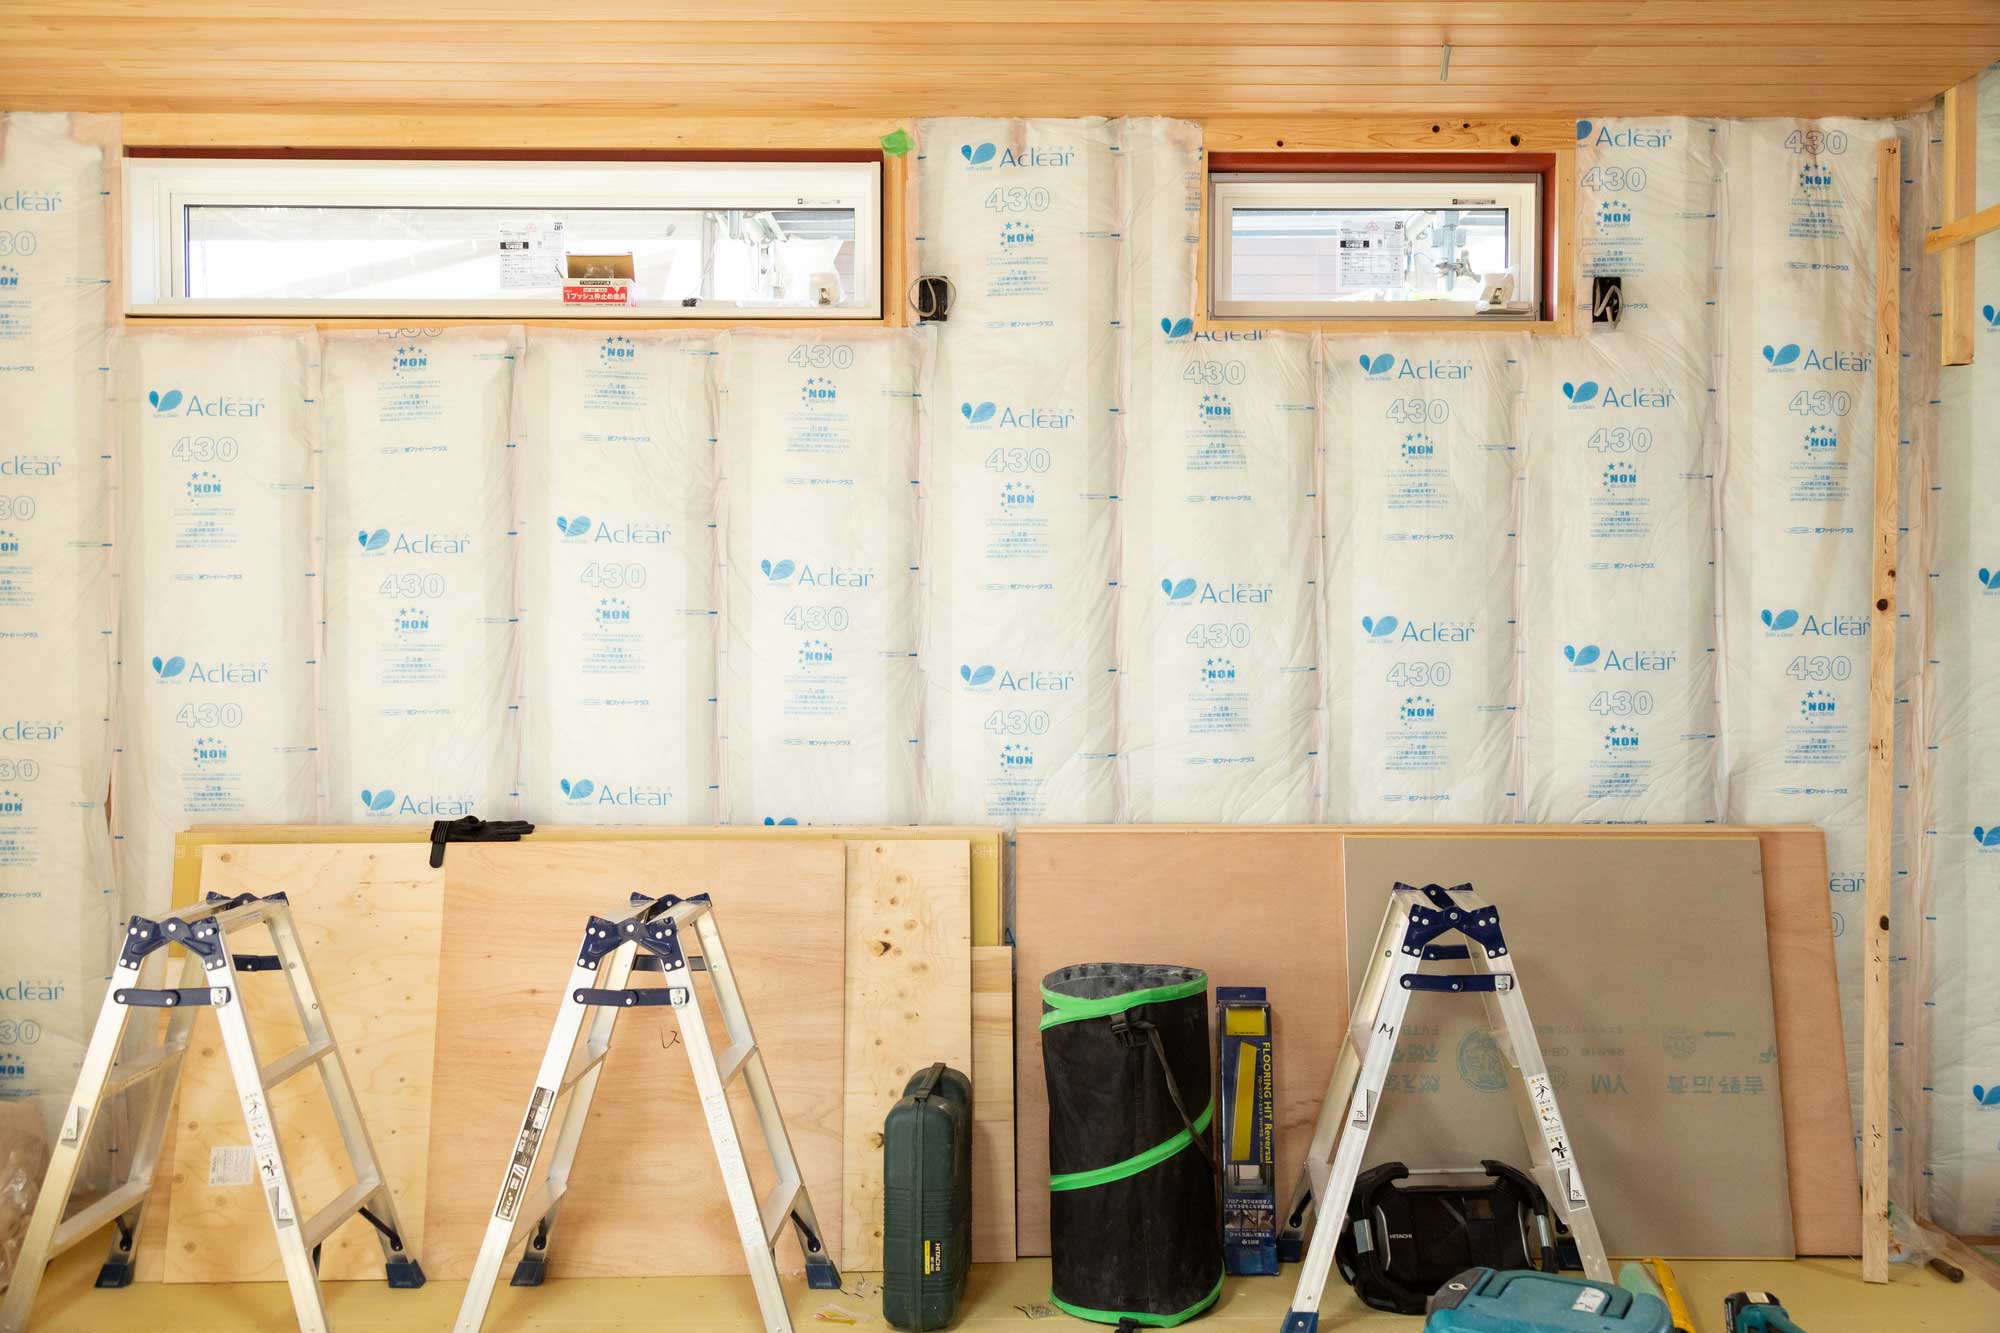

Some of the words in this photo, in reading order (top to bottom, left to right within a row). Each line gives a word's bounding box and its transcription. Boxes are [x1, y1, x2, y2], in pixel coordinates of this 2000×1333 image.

[1595, 126, 1672, 148] Aclear
[1784, 129, 1848, 155] 430
[999, 145, 1075, 168] Aclear
[1579, 166, 1647, 192] 430
[1804, 175, 1832, 187] NON
[0, 190, 62, 212] clear
[985, 186, 1050, 213] 430
[1602, 212, 1632, 224] NON
[1006, 232, 1035, 244] NON
[399, 355, 427, 367] NON
[606, 346, 635, 359] NON
[788, 343, 855, 369] 430
[1803, 348, 1872, 372] Aclear
[1182, 360, 1246, 386] 430
[1398, 358, 1472, 380] Aclear
[186, 394, 266, 417] Aclear
[807, 388, 836, 400] NON
[1602, 386, 1675, 408] Aclear
[1788, 390, 1852, 416] 430
[1000, 406, 1074, 429] Aclear
[1205, 405, 1231, 418] NON
[1385, 398, 1449, 424] 430
[172, 436, 239, 463] 430
[1408, 444, 1433, 456] NON
[1587, 427, 1652, 453] 430
[1807, 436, 1836, 449] NON
[985, 448, 1051, 473] 430
[193, 481, 222, 494] NON
[1609, 472, 1636, 485] NON
[1007, 492, 1035, 505] NON
[393, 533, 471, 555] Aclear
[594, 521, 672, 544] Aclear
[379, 573, 447, 599] 430
[580, 562, 646, 588] 430
[798, 564, 874, 588] Aclear
[1200, 582, 1273, 605] Aclear
[400, 618, 429, 631] NON
[601, 608, 630, 621] NON
[784, 606, 849, 631] 430
[1801, 614, 1871, 637] Aclear
[1186, 623, 1250, 648] 430
[1400, 620, 1476, 643] Aclear
[804, 650, 832, 662] NON
[1604, 649, 1676, 672] Aclear
[187, 661, 268, 683] Aclear
[1207, 668, 1235, 681] NON
[1385, 661, 1451, 687] 430
[1785, 656, 1851, 681] 430
[999, 670, 1074, 692] Aclear
[1407, 705, 1434, 717] NON
[1588, 690, 1653, 716] 430
[1806, 700, 1836, 713] NON
[176, 703, 243, 728] 430
[984, 710, 1050, 735] 430
[0, 720, 64, 742] clear
[1611, 735, 1639, 748] NON
[199, 748, 228, 760] NON
[1005, 753, 1033, 766] NON
[399, 794, 475, 818] Aclear
[598, 784, 672, 807] Aclear
[0, 802, 24, 813] ON
[0, 978, 64, 1002] clear
[1262, 1042, 1272, 1098] FLOORING
[1263, 1101, 1272, 1121] HIT
[1264, 1123, 1272, 1164] Reversal
